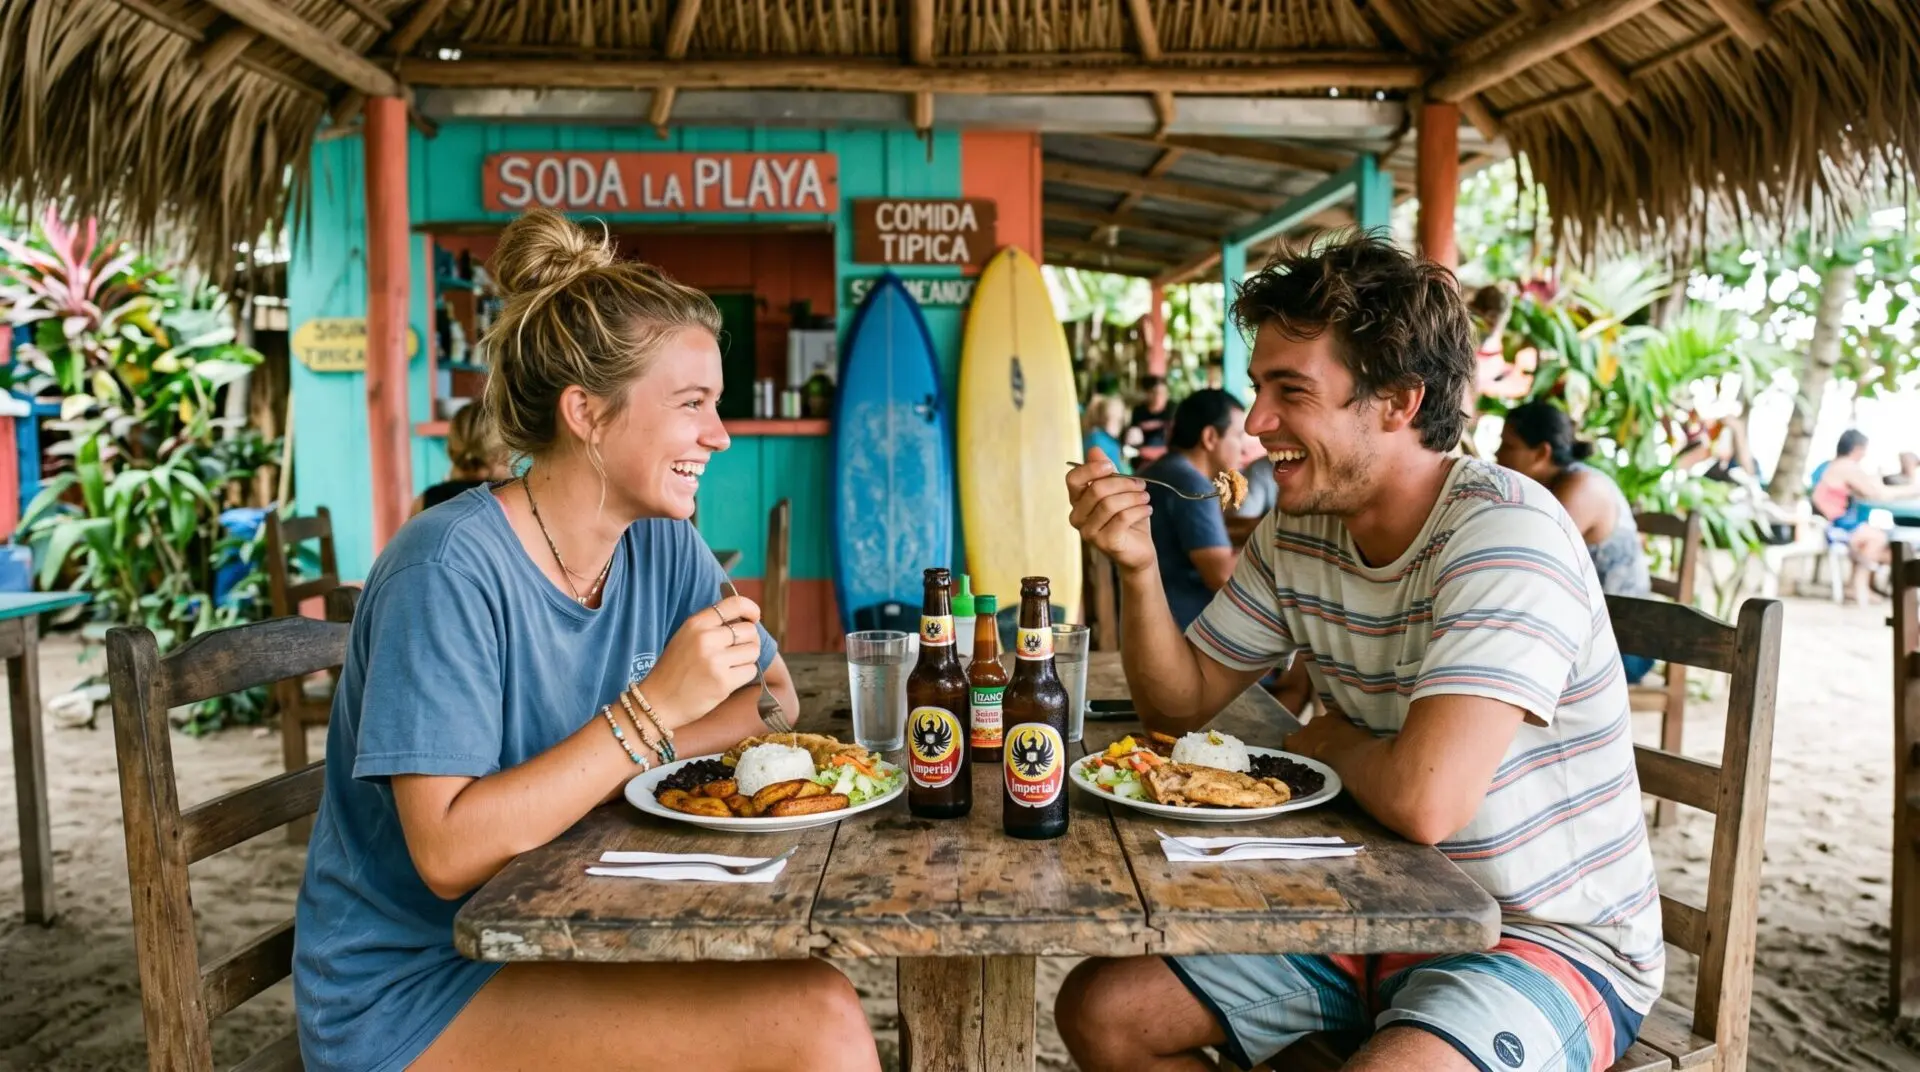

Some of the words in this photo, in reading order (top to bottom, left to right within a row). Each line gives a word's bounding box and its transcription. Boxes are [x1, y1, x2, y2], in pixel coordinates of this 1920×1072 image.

[500, 157, 627, 208] SODA
[642, 173, 685, 207] LA
[694, 157, 826, 208] PLAYA
[875, 202, 978, 232] COMIDA
[879, 233, 970, 262] TIPICA
[974, 691, 1003, 704] LIZANO
[913, 759, 953, 776] Imperial
[1011, 777, 1055, 797] Imperial
